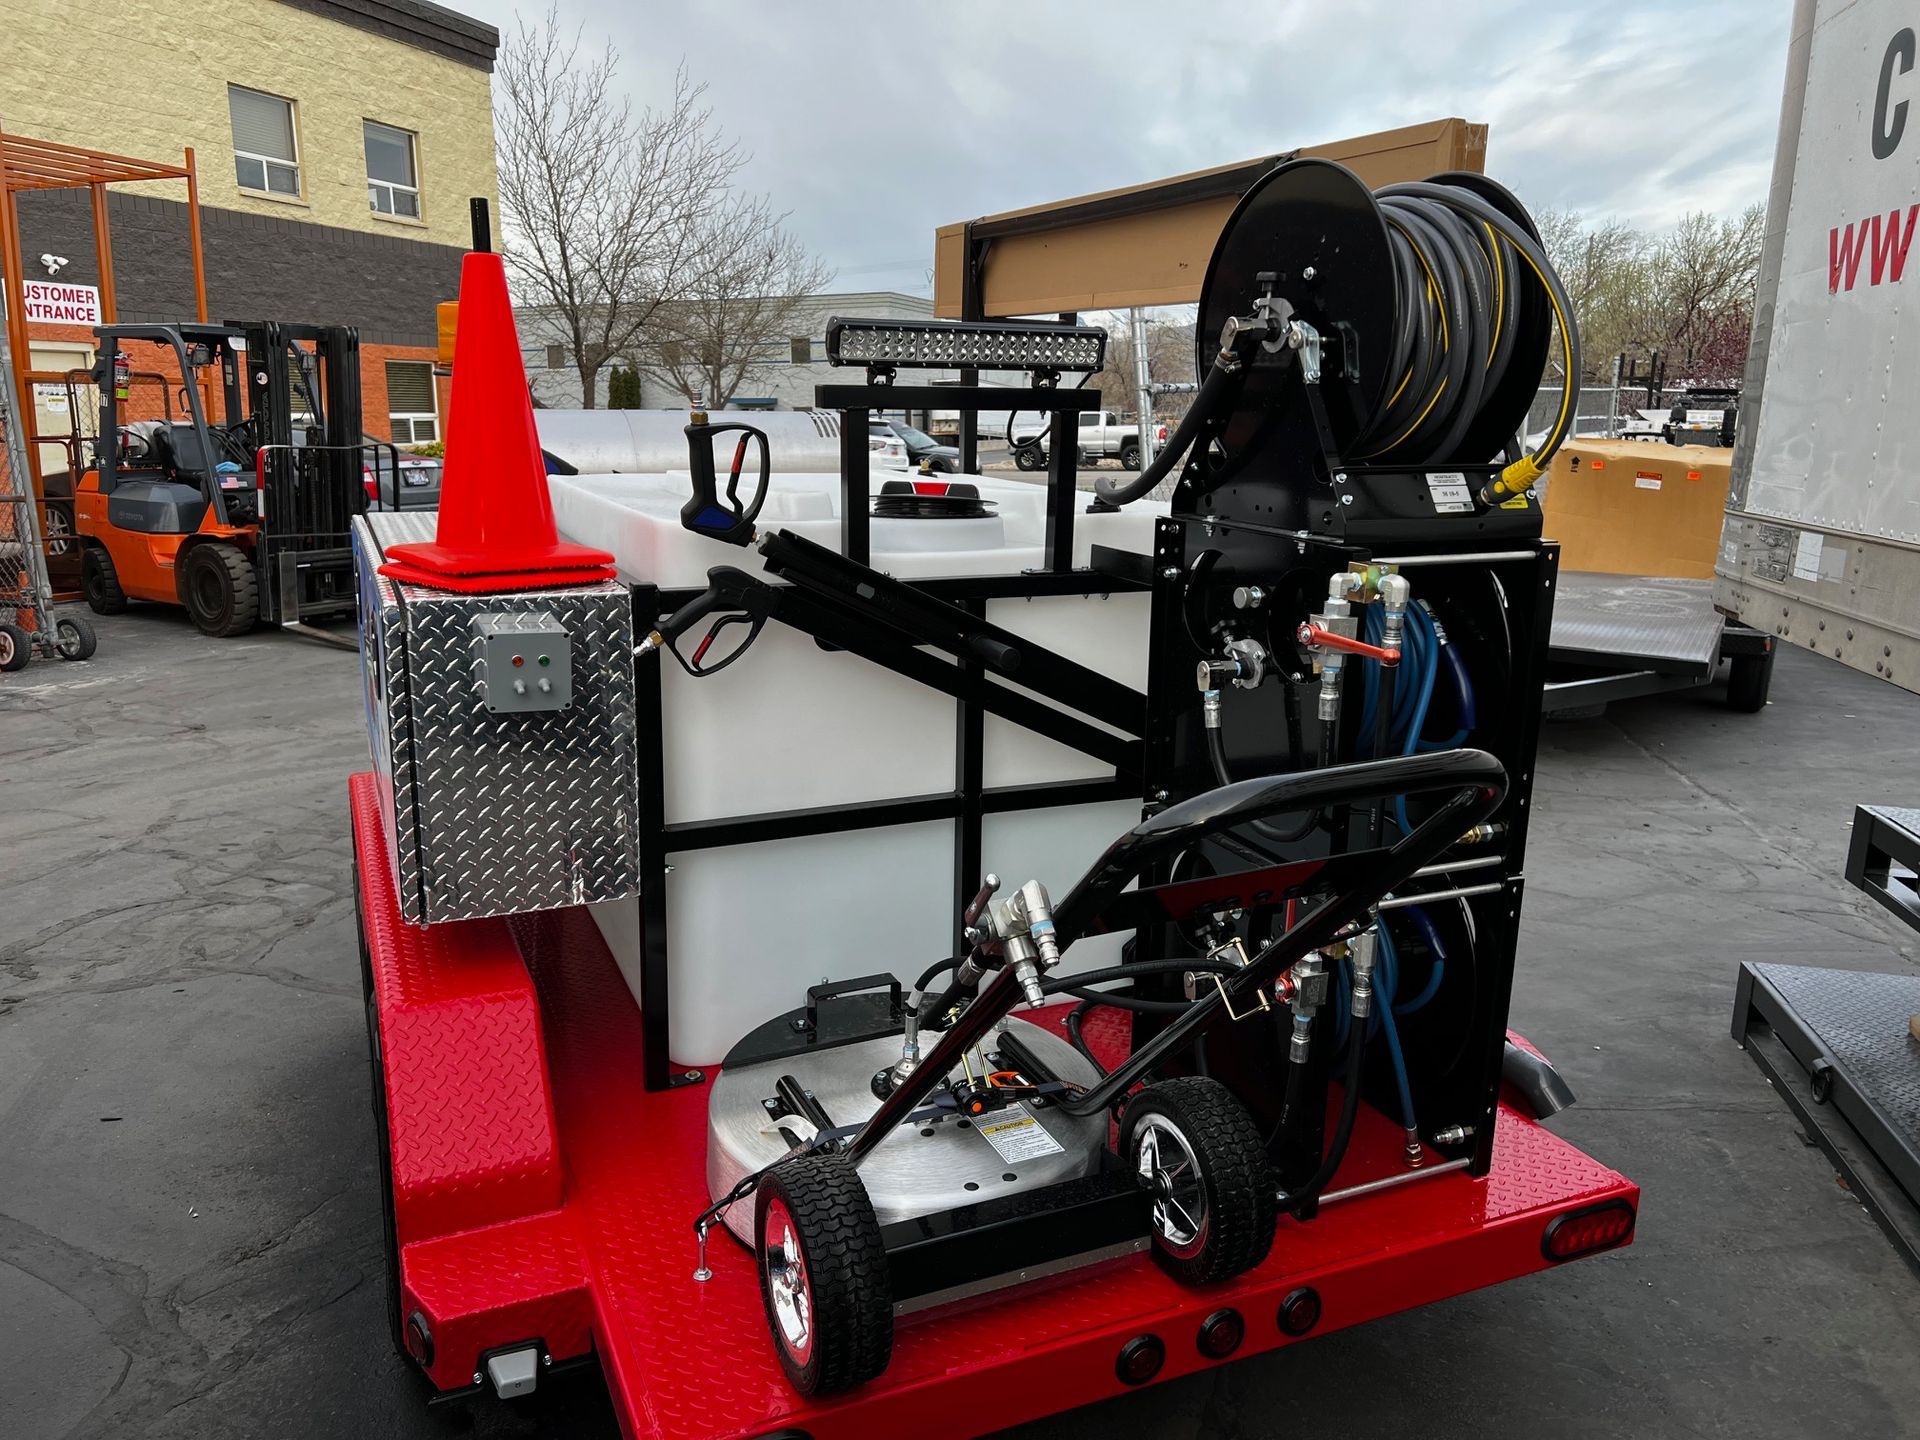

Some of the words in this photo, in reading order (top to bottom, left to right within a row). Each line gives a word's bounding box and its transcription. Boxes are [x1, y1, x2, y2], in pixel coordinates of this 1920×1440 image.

[1871, 27, 1917, 160] C
[24, 285, 95, 304] USTOMER
[25, 303, 96, 322] NTRANCE
